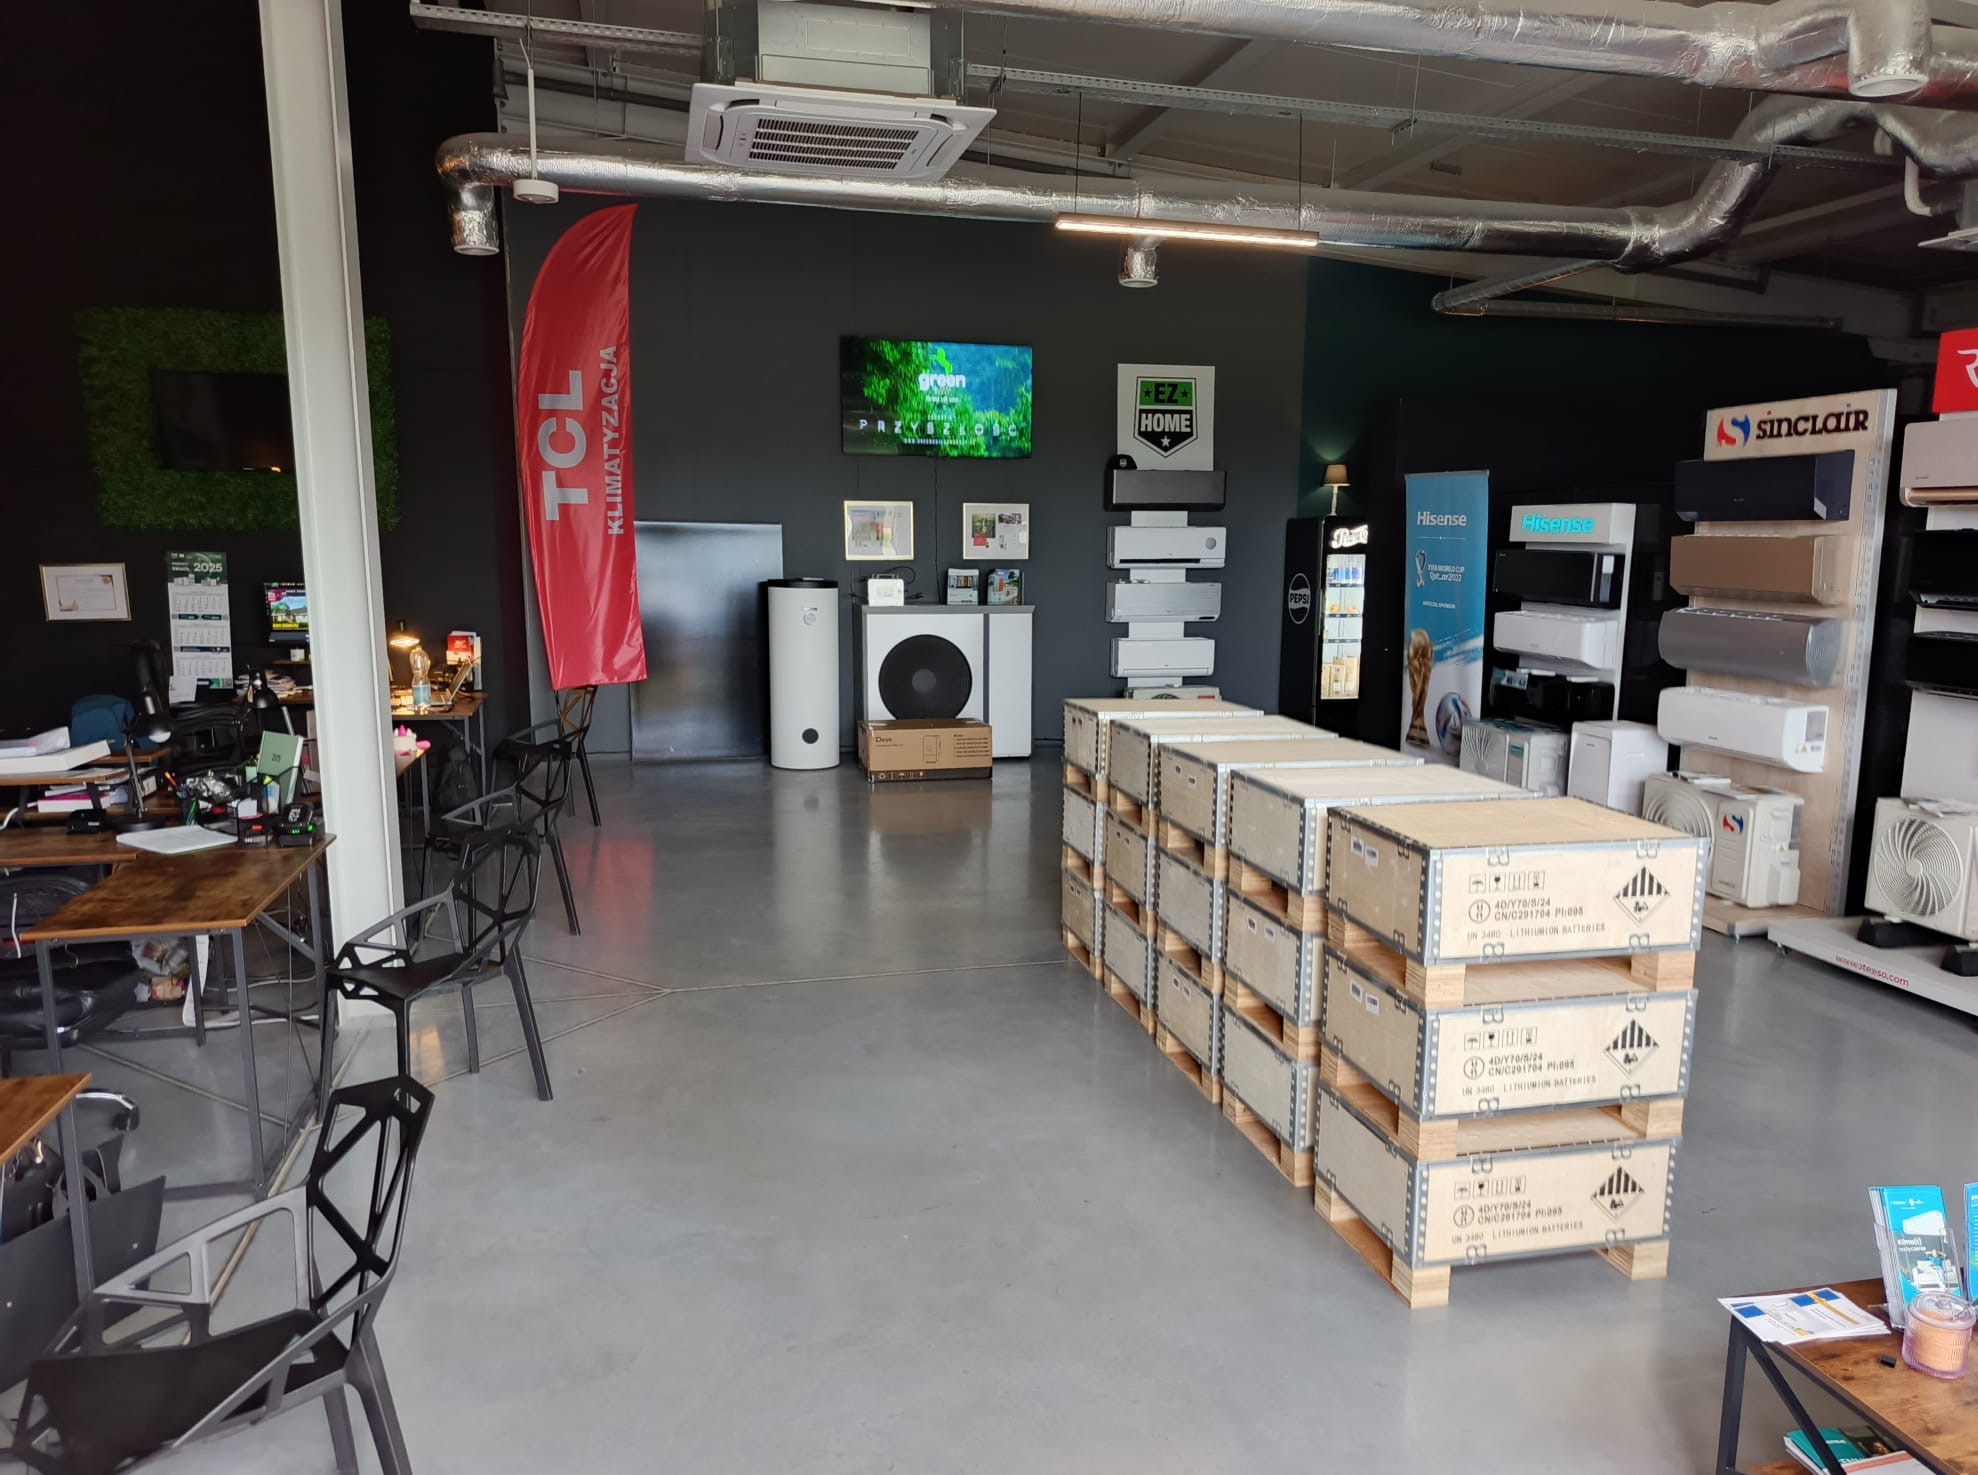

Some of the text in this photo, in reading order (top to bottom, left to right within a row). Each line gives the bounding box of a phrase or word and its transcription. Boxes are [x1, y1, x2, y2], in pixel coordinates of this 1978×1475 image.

[918, 374, 966, 391] green
[1154, 383, 1178, 403] EZ
[1141, 413, 1191, 432] HOME
[538, 370, 588, 521] TCL
[600, 346, 624, 535] KLIMATYZACJA
[1417, 512, 1467, 526] Hisense
[1522, 513, 1594, 534] Hisense
[194, 563, 222, 572] 2025
[1290, 593, 1309, 604] PEPSI
[1467, 931, 1478, 940] UN
[1562, 923, 1606, 935] BATTERIES
[1554, 1075, 1596, 1088] BATTERIES
[1542, 1222, 1583, 1234] BATTERIES
